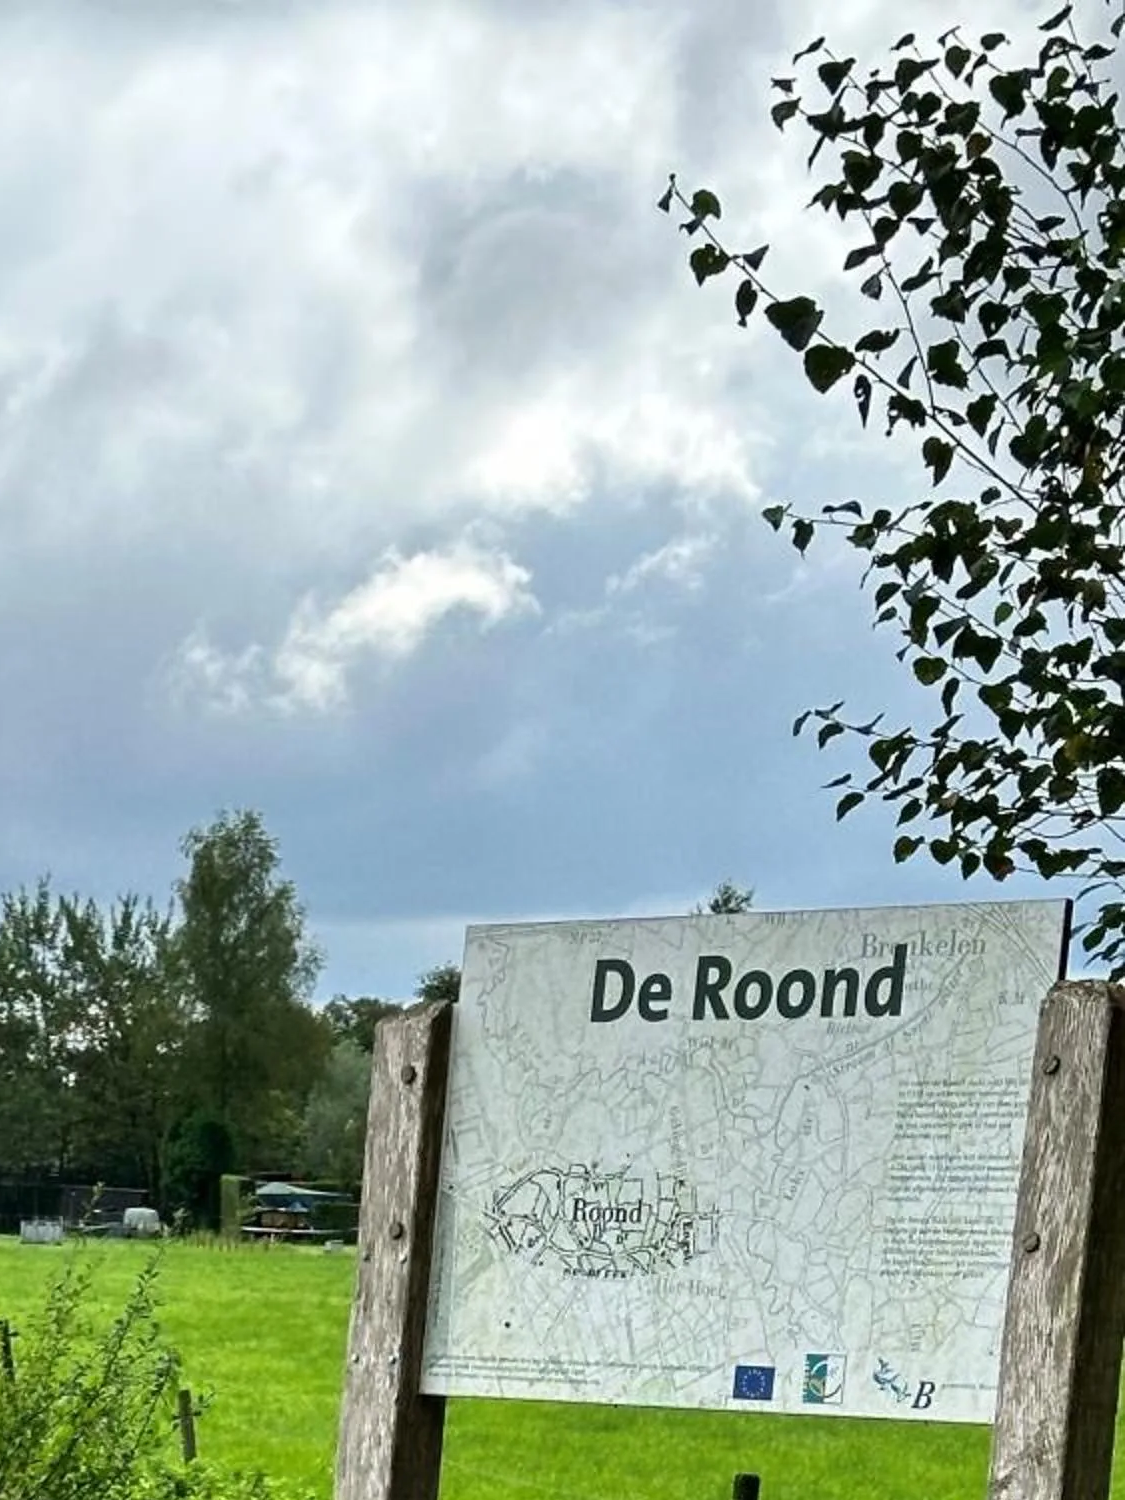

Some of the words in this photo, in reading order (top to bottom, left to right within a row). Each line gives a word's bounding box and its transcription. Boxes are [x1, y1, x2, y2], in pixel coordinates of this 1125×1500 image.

[590, 958, 673, 1023] De
[691, 943, 908, 1021] Roond
[572, 1198, 643, 1223] Roond
